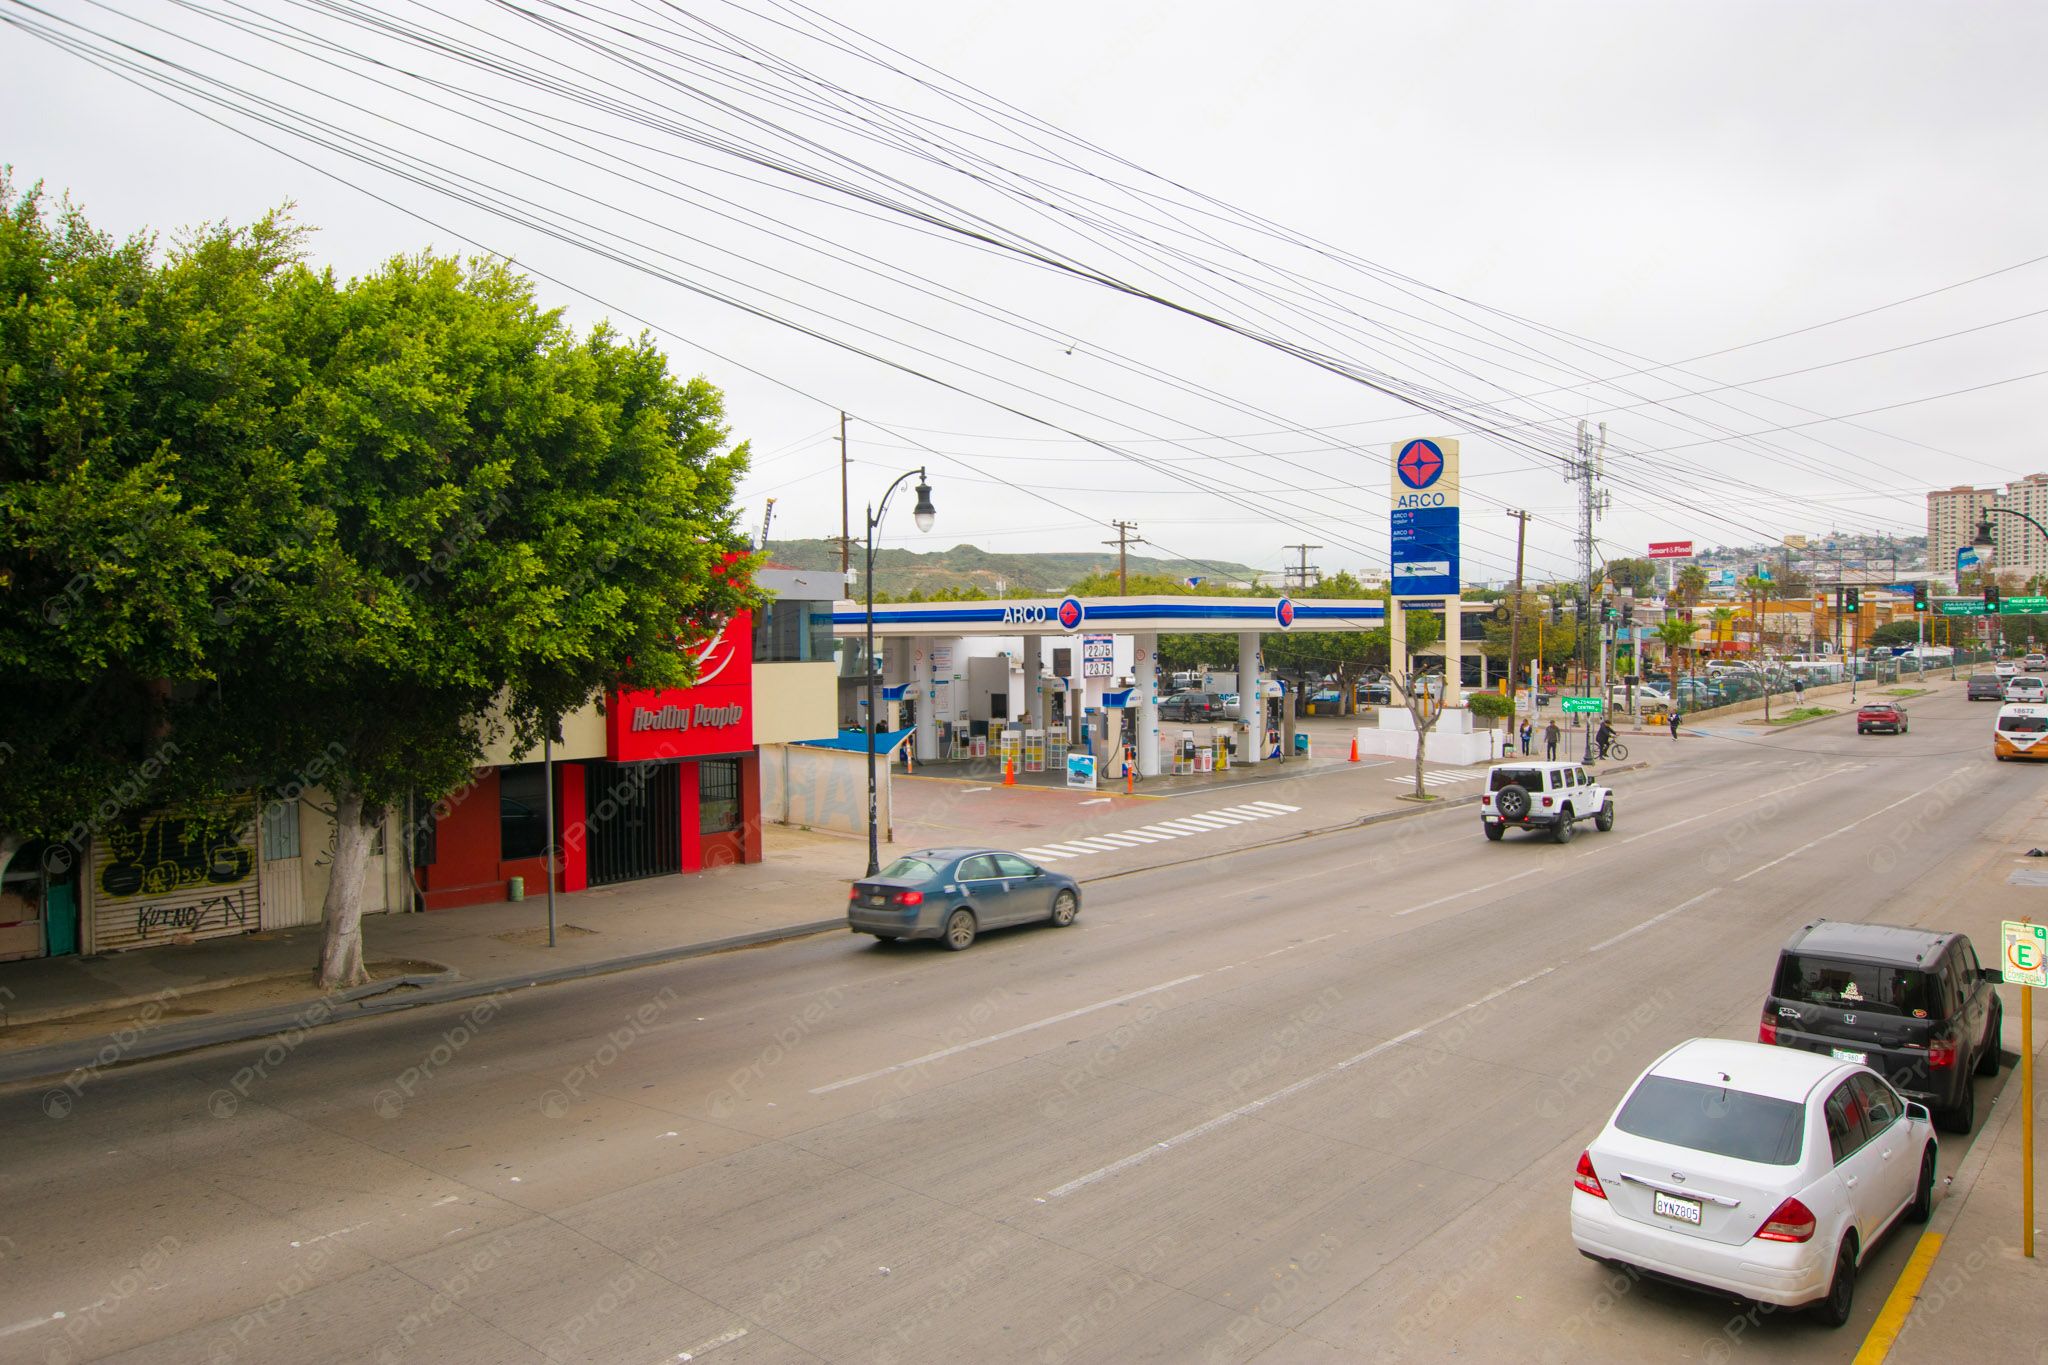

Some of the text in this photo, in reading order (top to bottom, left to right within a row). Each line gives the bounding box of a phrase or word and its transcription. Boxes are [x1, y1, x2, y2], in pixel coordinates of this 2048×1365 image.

[1398, 493, 1445, 508] ARCO
[1003, 605, 1047, 624] ARCO
[632, 702, 743, 732] Healthy People
[2018, 945, 2033, 966] E
[1657, 1200, 1698, 1220] 8YNZ805
